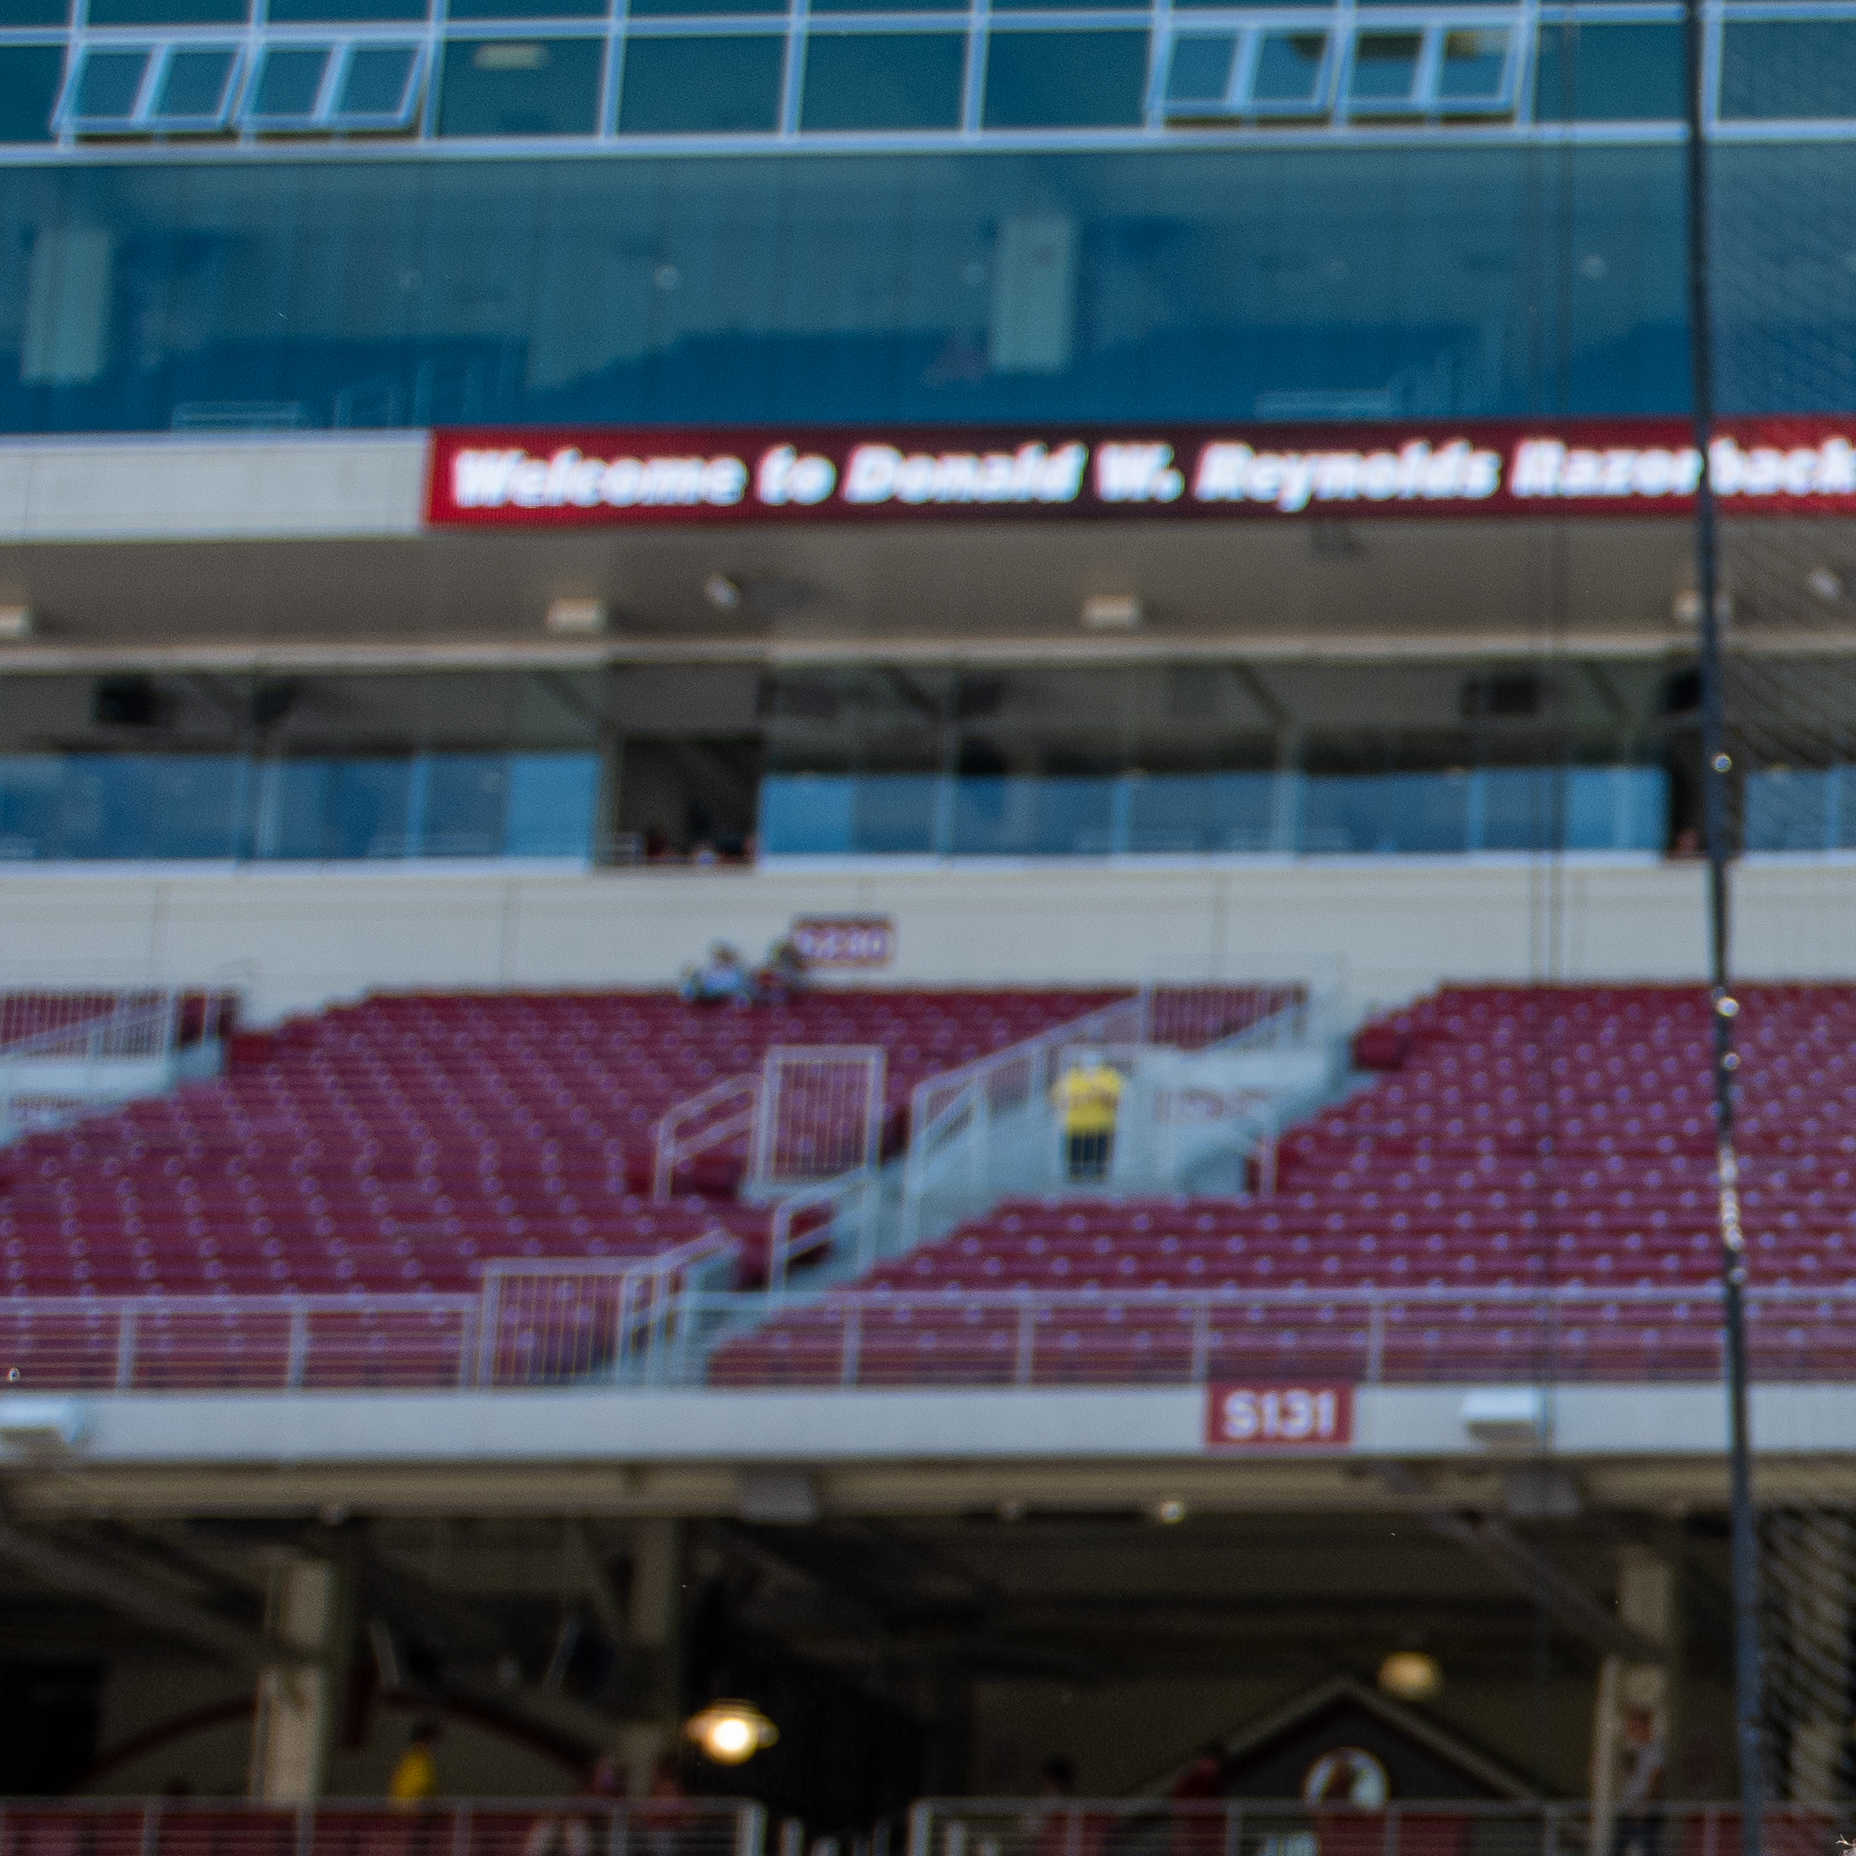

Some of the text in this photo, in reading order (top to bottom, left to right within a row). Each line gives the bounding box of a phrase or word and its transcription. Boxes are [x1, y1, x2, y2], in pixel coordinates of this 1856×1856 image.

[453, 449, 748, 508] Welcome
[759, 448, 838, 505] to
[845, 443, 1087, 504] Donald
[1097, 443, 1186, 502] W.
[1196, 440, 1500, 512] Reynolds
[1223, 1389, 1335, 1438] S131
